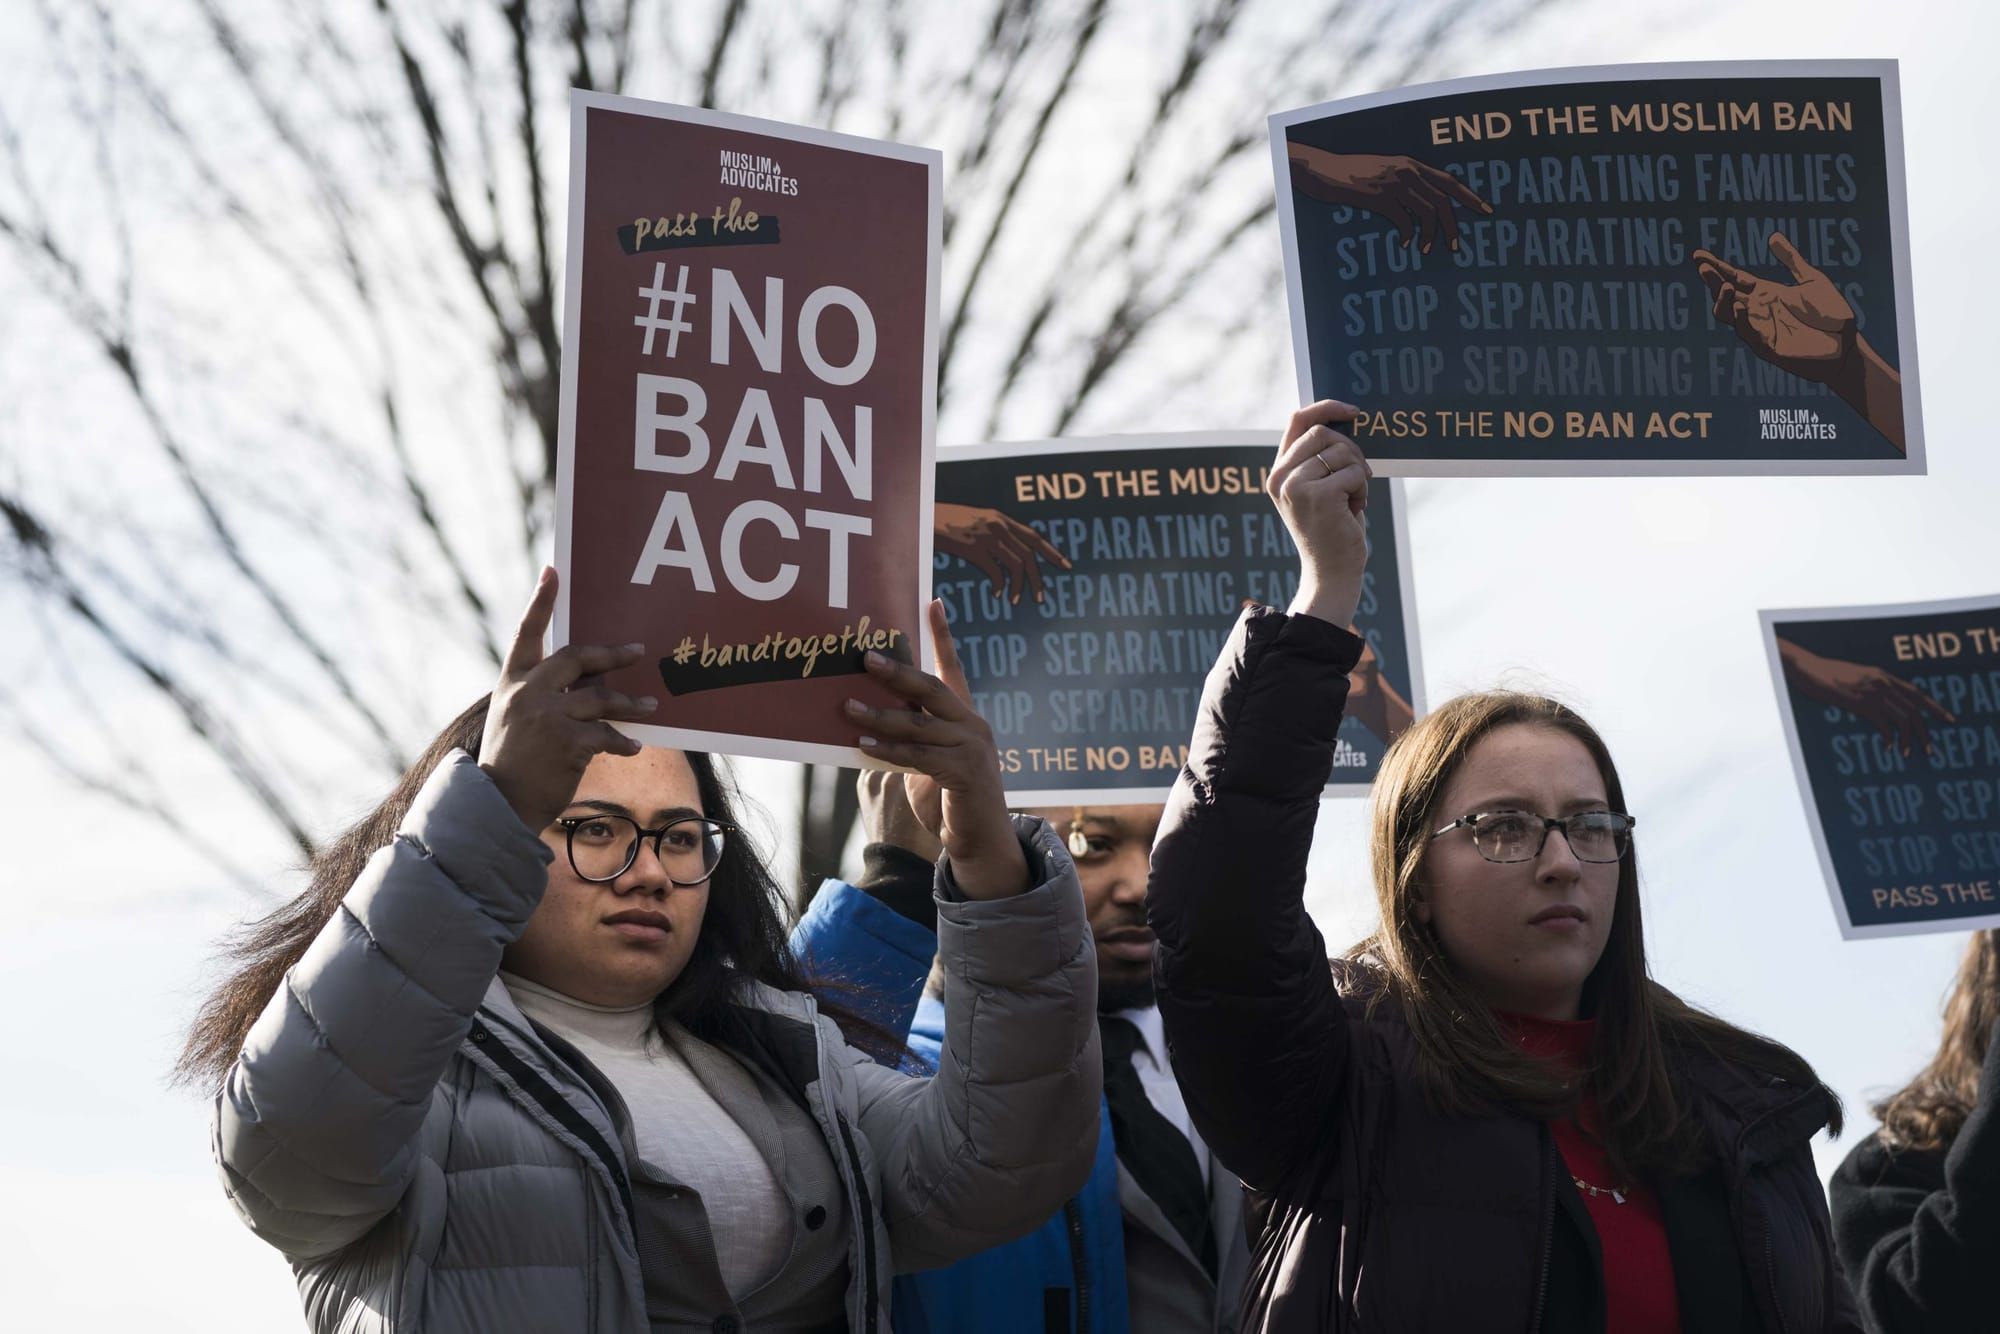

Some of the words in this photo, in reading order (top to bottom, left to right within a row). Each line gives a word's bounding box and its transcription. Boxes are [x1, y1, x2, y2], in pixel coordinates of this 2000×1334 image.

[1430, 111, 1513, 145] END
[1520, 104, 1599, 136] THE
[1610, 101, 1761, 133] MUSLIM
[1772, 101, 1853, 131] BAN
[720, 150, 772, 175] MUSLIM
[720, 167, 798, 196] ADVOCATES
[1695, 152, 1858, 203] FAMILIES
[634, 211, 697, 251] pass
[711, 197, 760, 236] the
[1453, 216, 1686, 269] SEPARATING
[634, 261, 878, 386] #NO
[1342, 284, 1439, 338] STOP
[1456, 280, 1690, 332] SEPARATING
[1347, 346, 1445, 397] STOP
[1463, 345, 1694, 397] SEPARATING
[634, 372, 873, 502] BAN
[1353, 411, 1428, 438] PASS
[1435, 411, 1495, 438] THE
[1503, 410, 1555, 439] NO
[1565, 411, 1634, 439] BAN
[1644, 411, 1713, 439] ACT
[1759, 408, 1810, 425] MUSLIM
[1761, 423, 1837, 440] ADVOCATES
[1015, 472, 1088, 502] END
[1093, 469, 1161, 498] THE
[1169, 466, 1268, 496] MUSLI
[630, 490, 873, 610] ACT
[1037, 570, 1237, 619] SEPARATING
[673, 615, 901, 678] #bandtogether
[953, 632, 1028, 680] TOP
[1042, 627, 1231, 676] SEPARATIN
[1892, 630, 1962, 662] END
[1026, 747, 1080, 773] THE
[1085, 746, 1131, 772] NO
[1845, 783, 1924, 827] STOP
[1859, 834, 1938, 877] STOP
[1871, 884, 1939, 909] PASS
[1940, 881, 1996, 904] THE
